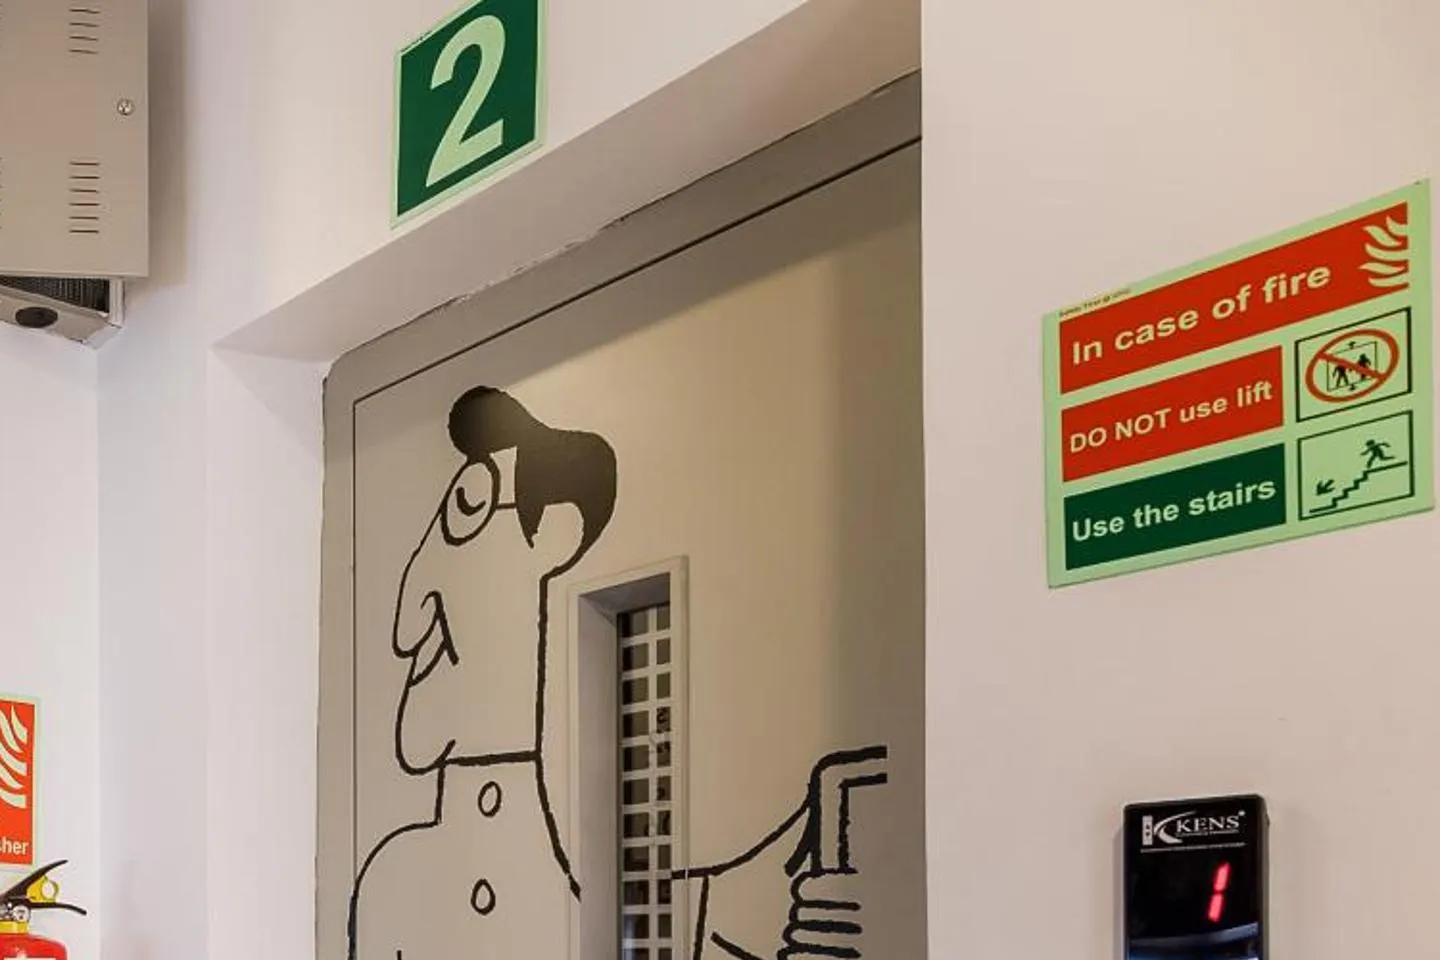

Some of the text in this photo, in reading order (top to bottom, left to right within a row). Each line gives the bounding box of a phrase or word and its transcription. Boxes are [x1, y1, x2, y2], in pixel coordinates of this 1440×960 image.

[426, 15, 506, 188] 2
[1072, 264, 1331, 365] In case of fire
[1070, 381, 1274, 453] DO NOT use lift
[1072, 478, 1277, 542] Use the stairs
[1176, 815, 1240, 833] KENS
[1208, 861, 1232, 923] 1
